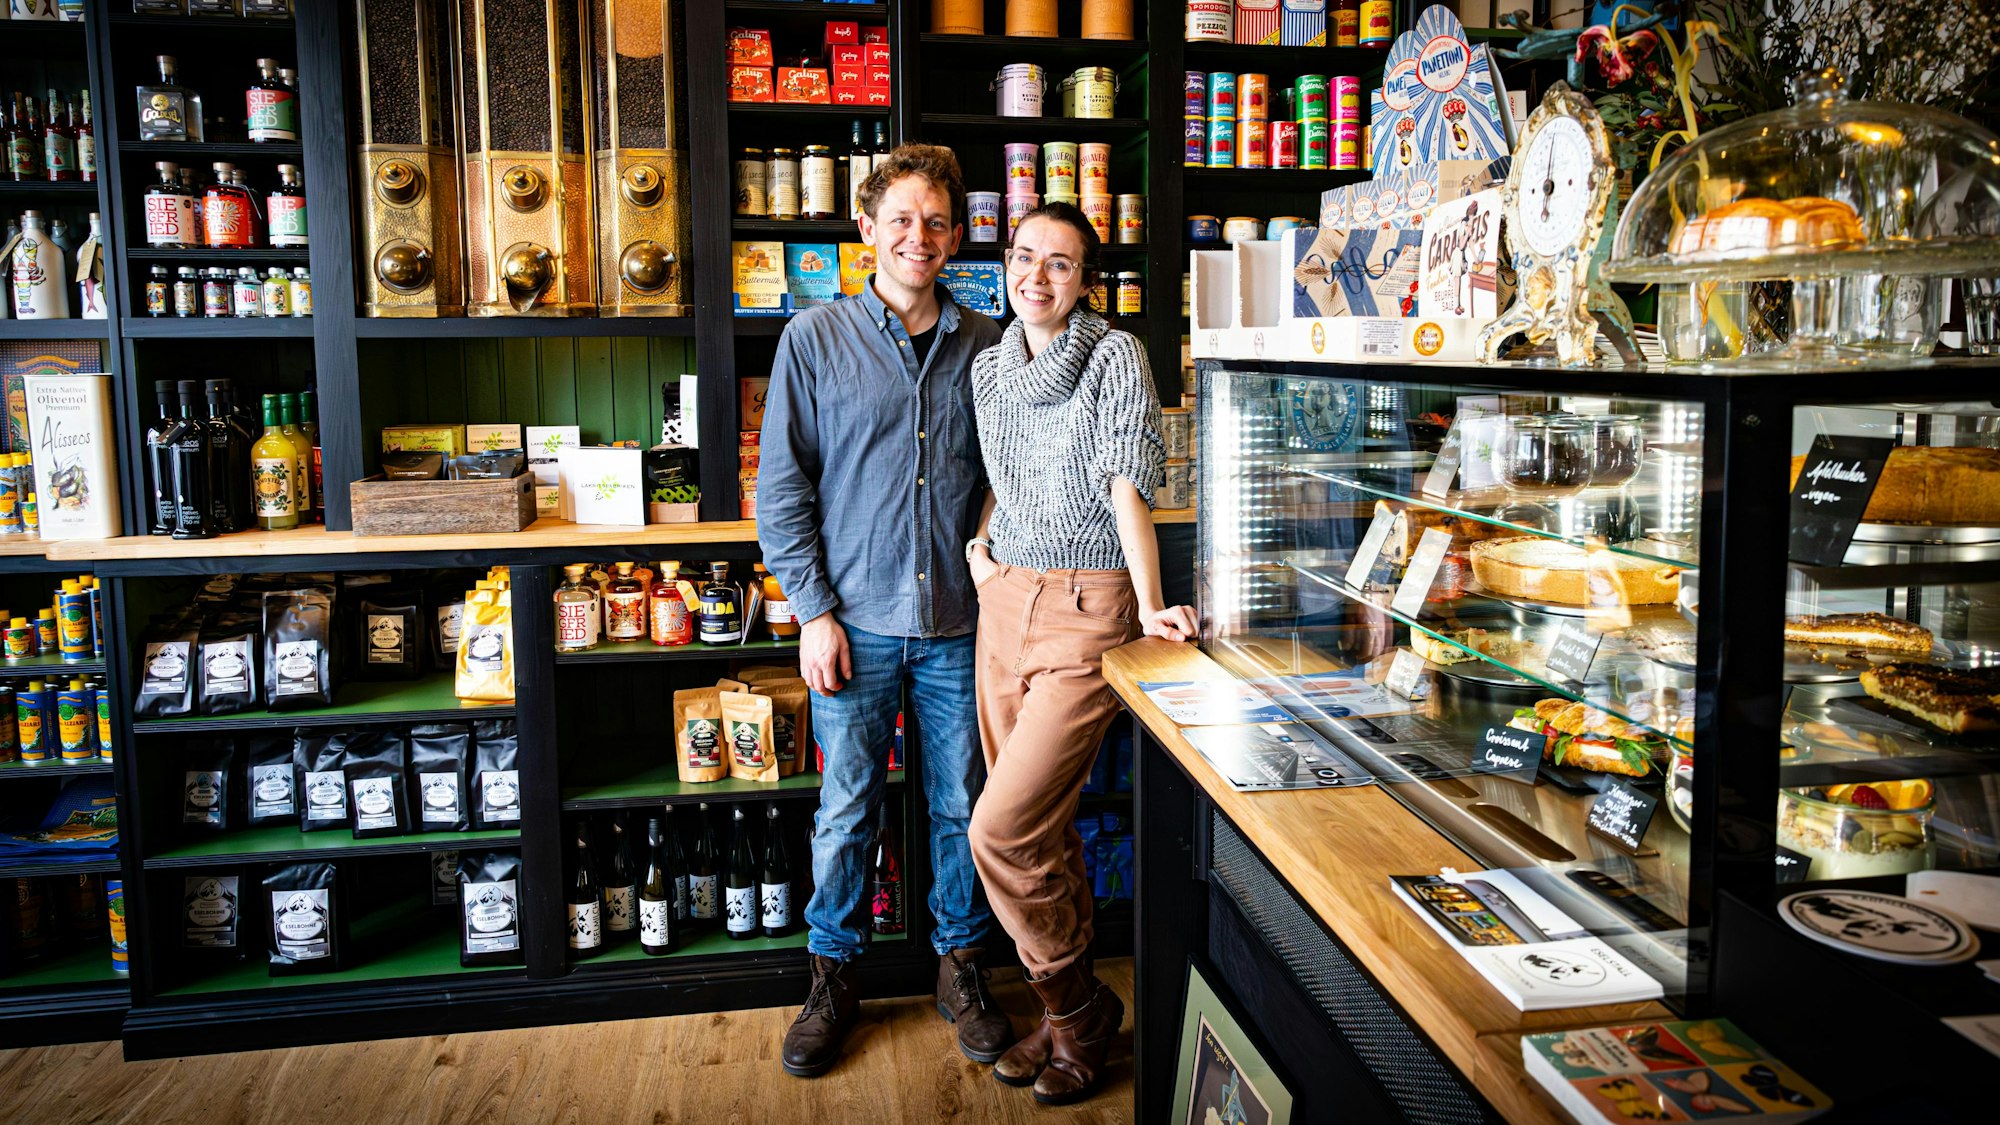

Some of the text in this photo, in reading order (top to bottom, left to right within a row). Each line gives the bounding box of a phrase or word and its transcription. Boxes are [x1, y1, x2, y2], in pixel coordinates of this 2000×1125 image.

[1420, 46, 1464, 77] PANETTONI
[732, 68, 763, 78] Galup
[788, 69, 819, 80] Galup
[148, 198, 177, 212] SIE
[148, 211, 179, 223] GFR
[150, 223, 179, 236] IED
[736, 275, 781, 286] Buttermilk
[790, 277, 835, 288] Buttermilk
[36, 386, 87, 394] Extra Natives
[558, 604, 586, 618] SIE
[558, 618, 586, 628] GFR
[559, 629, 586, 640] IED
[1485, 727, 1530, 752] Croissant
[476, 913, 506, 922] ESELBOHNE
[658, 900, 668, 945] ESELMILCH
